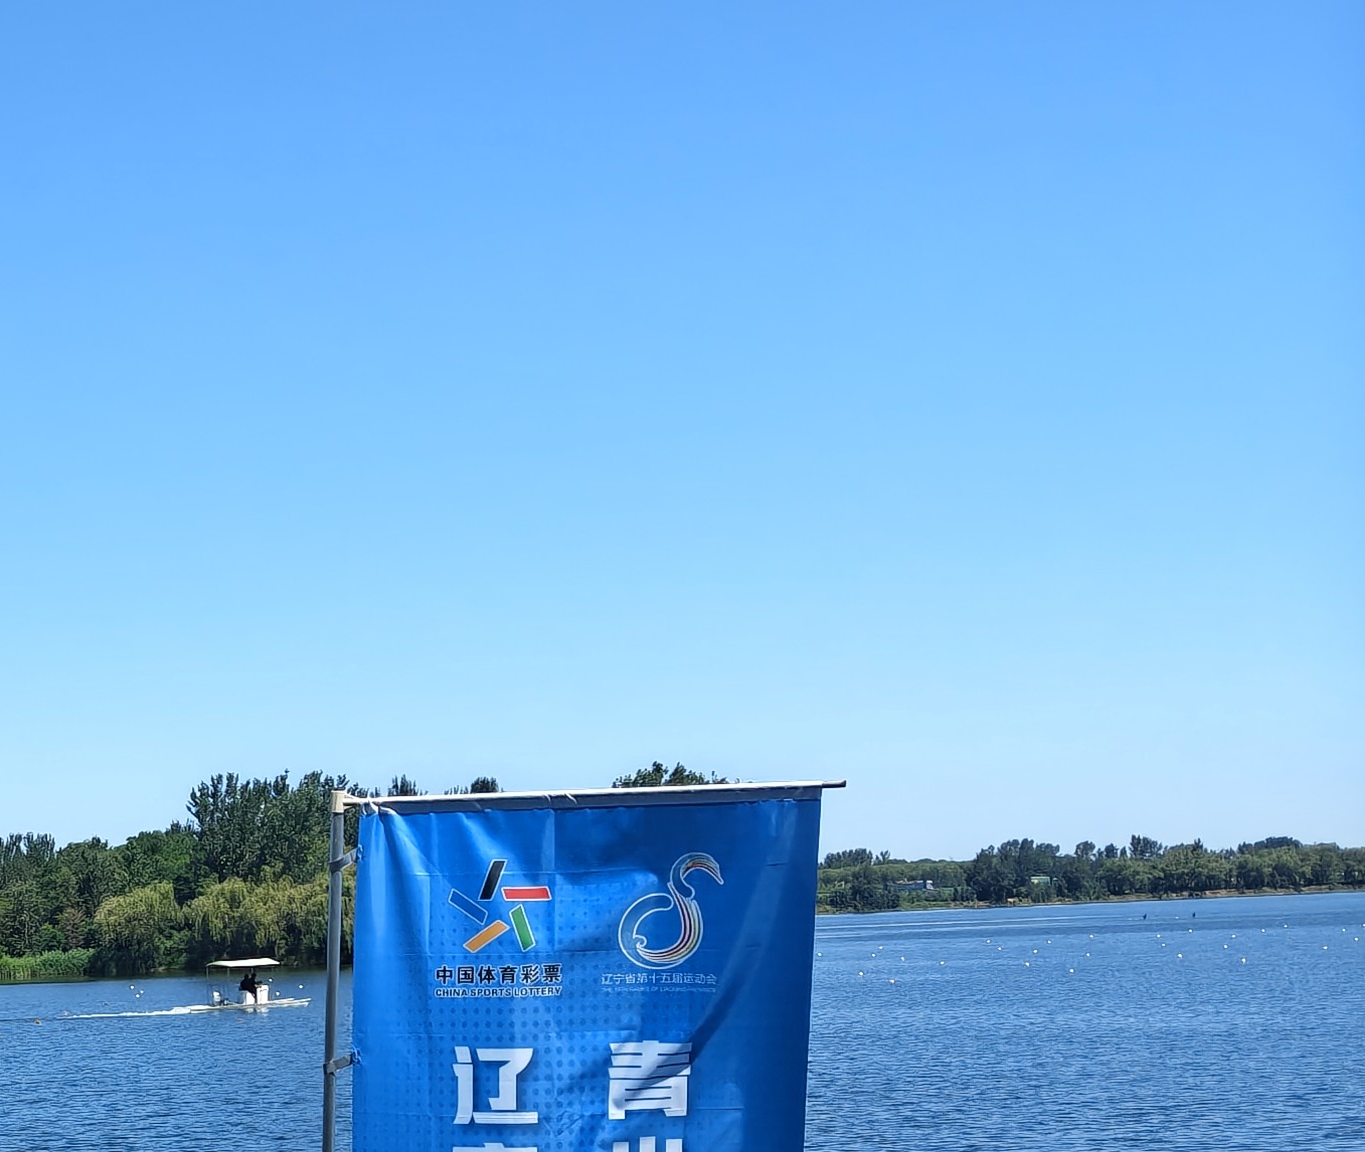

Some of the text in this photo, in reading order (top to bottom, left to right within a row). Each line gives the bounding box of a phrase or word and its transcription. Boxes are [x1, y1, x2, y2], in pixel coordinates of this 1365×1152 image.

[435, 963, 561, 985] 中国体育彩票
[601, 972, 718, 985] 辽宁省第十五届运动会
[435, 985, 562, 997] CHINA SPORTS LOTTERY
